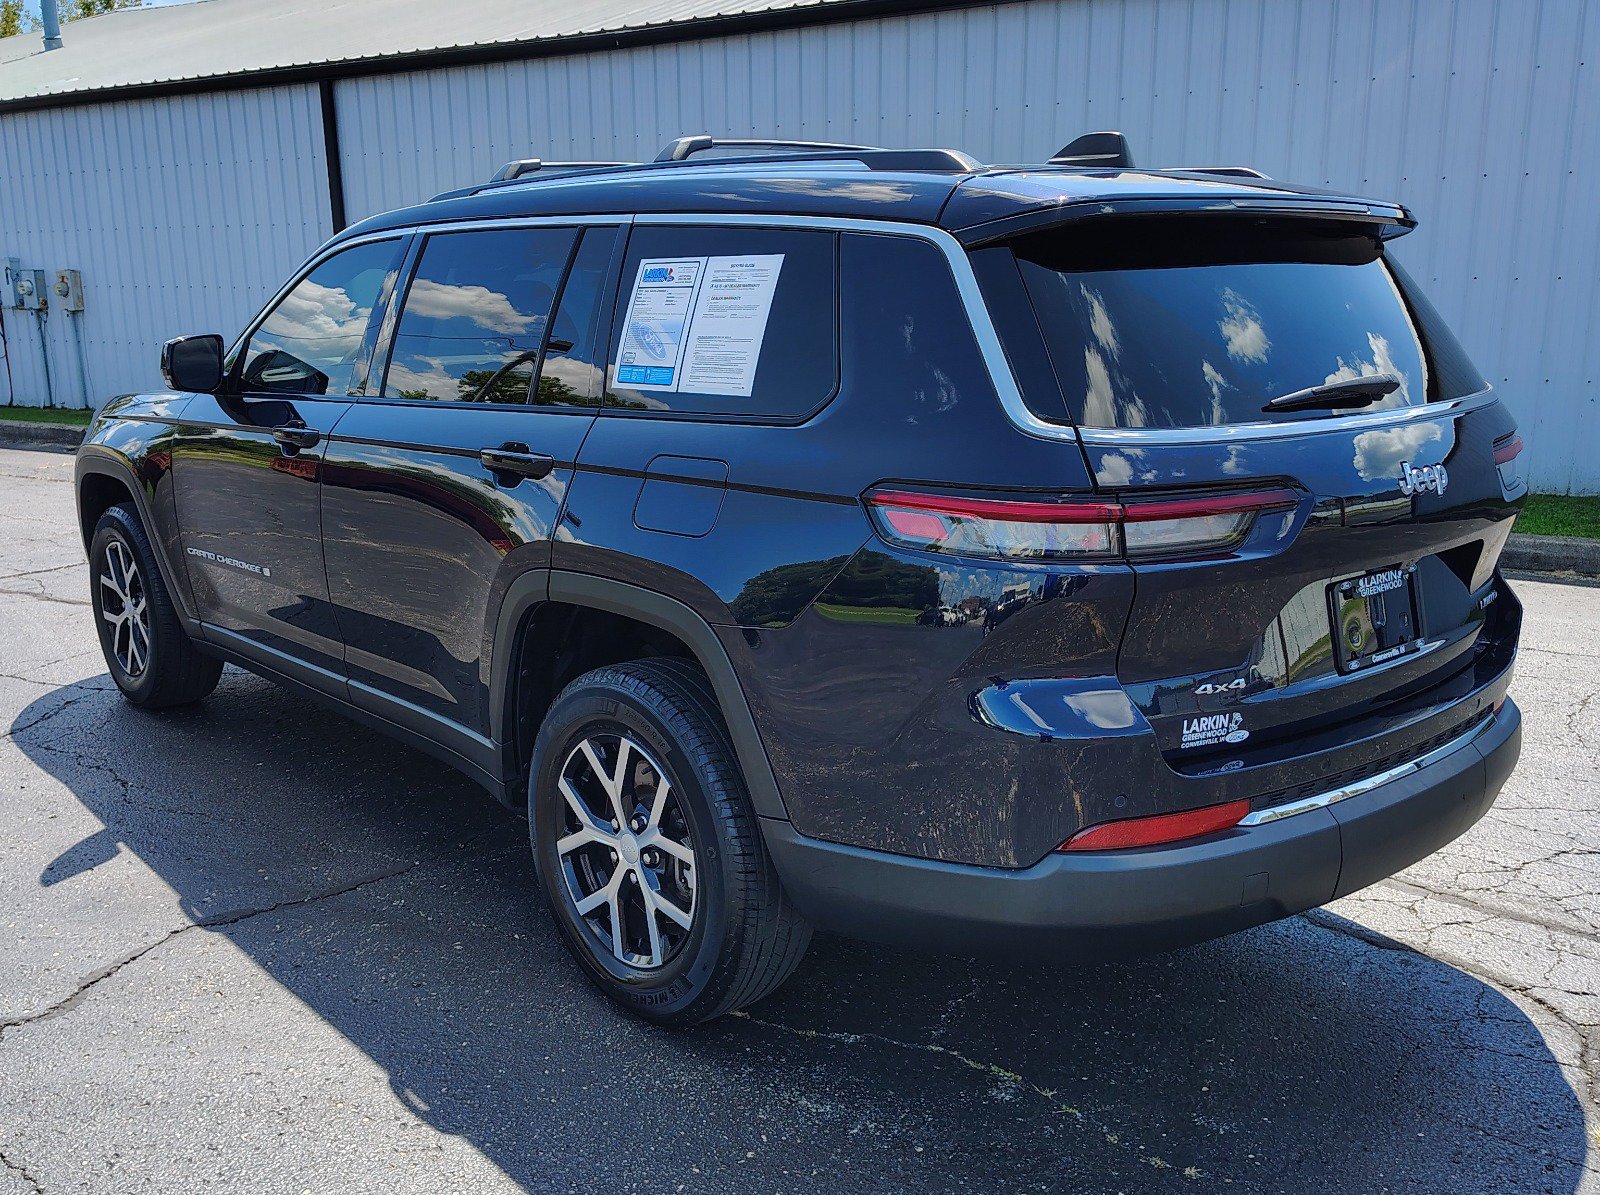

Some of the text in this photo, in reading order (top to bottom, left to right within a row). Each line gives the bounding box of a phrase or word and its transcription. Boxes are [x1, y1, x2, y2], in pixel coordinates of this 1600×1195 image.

[1398, 461, 1448, 496] Jeep
[186, 547, 215, 561] GRAND
[216, 554, 262, 574] CHEROKEE
[1364, 569, 1398, 588] LARKIN
[1194, 677, 1247, 695] 4x4
[1182, 713, 1229, 735] LARKIN
